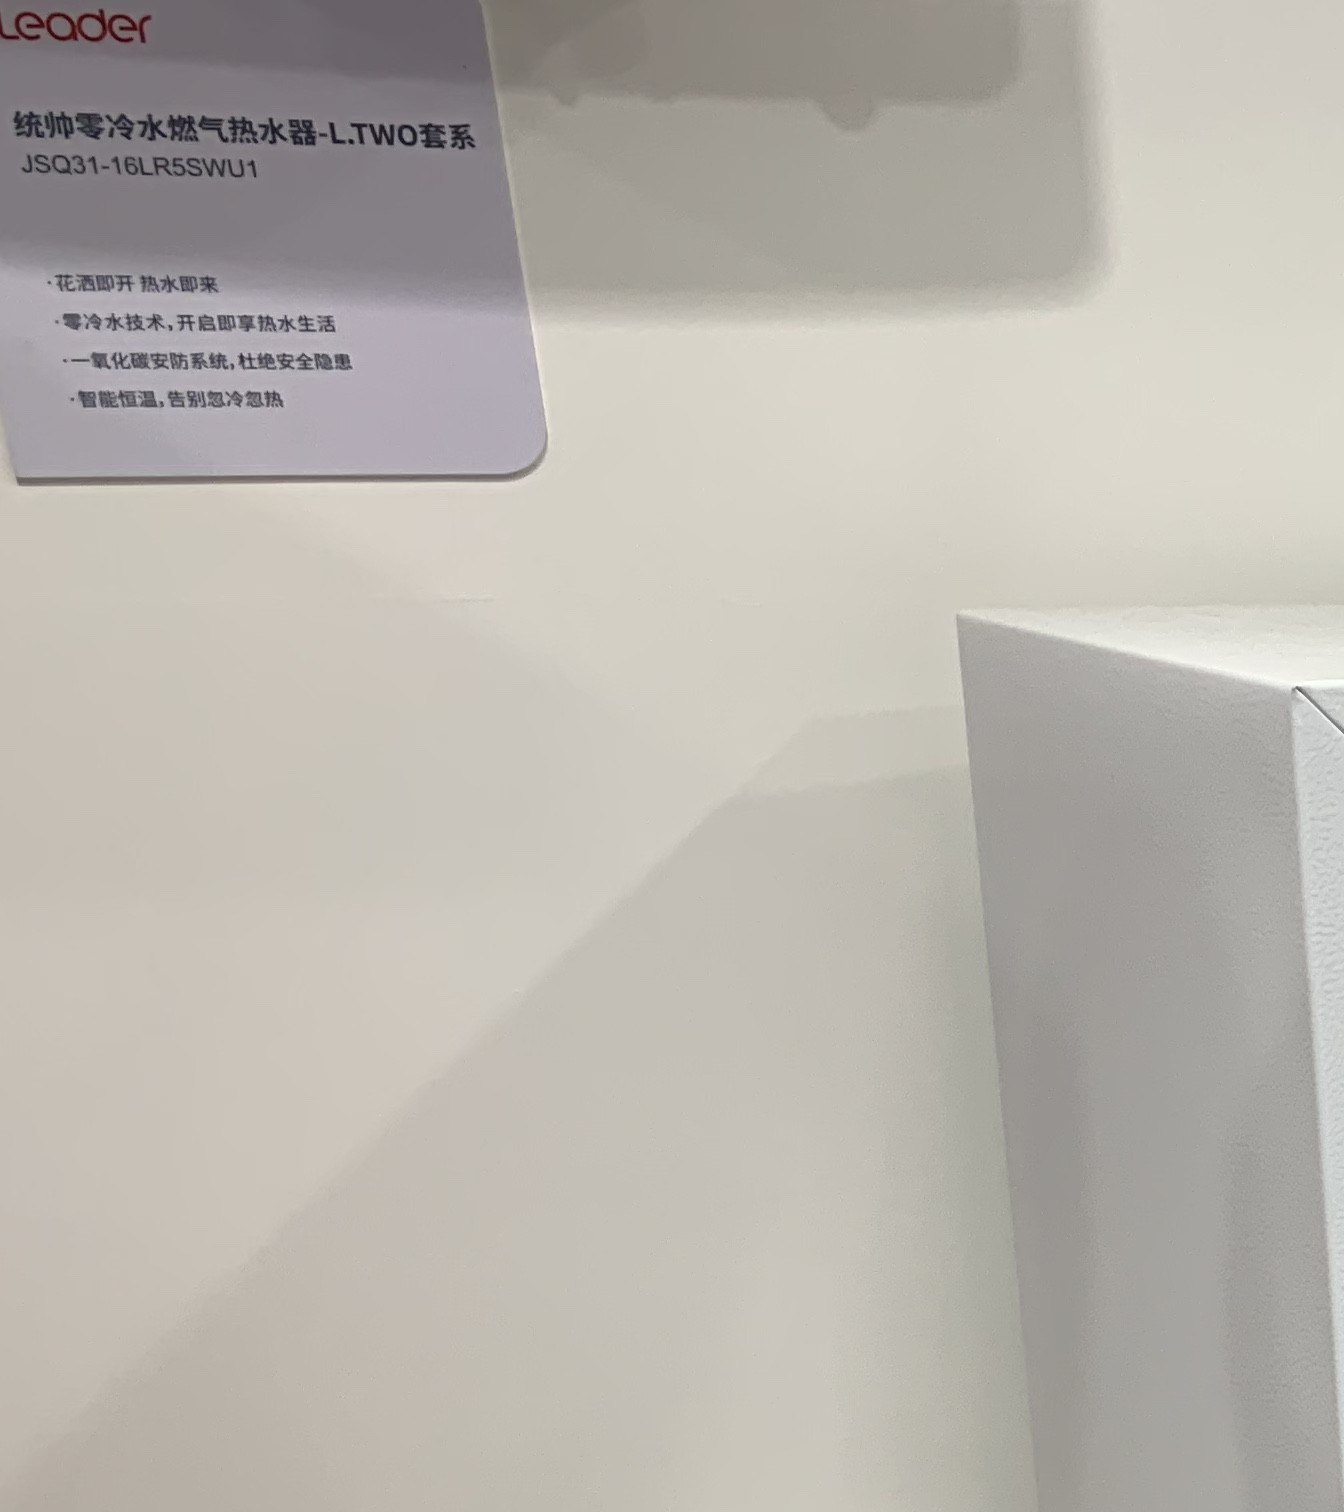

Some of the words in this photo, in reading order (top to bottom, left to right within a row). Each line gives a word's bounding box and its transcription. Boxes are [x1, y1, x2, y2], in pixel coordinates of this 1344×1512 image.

[0, 8, 152, 44] Leader
[13, 110, 478, 151] 统帅零冷水燃气热水器-L.TWO套系
[21, 154, 259, 179] JSQ31-16LR5SWU1
[55, 274, 135, 293] 花洒即开
[140, 274, 220, 294] 热水即来
